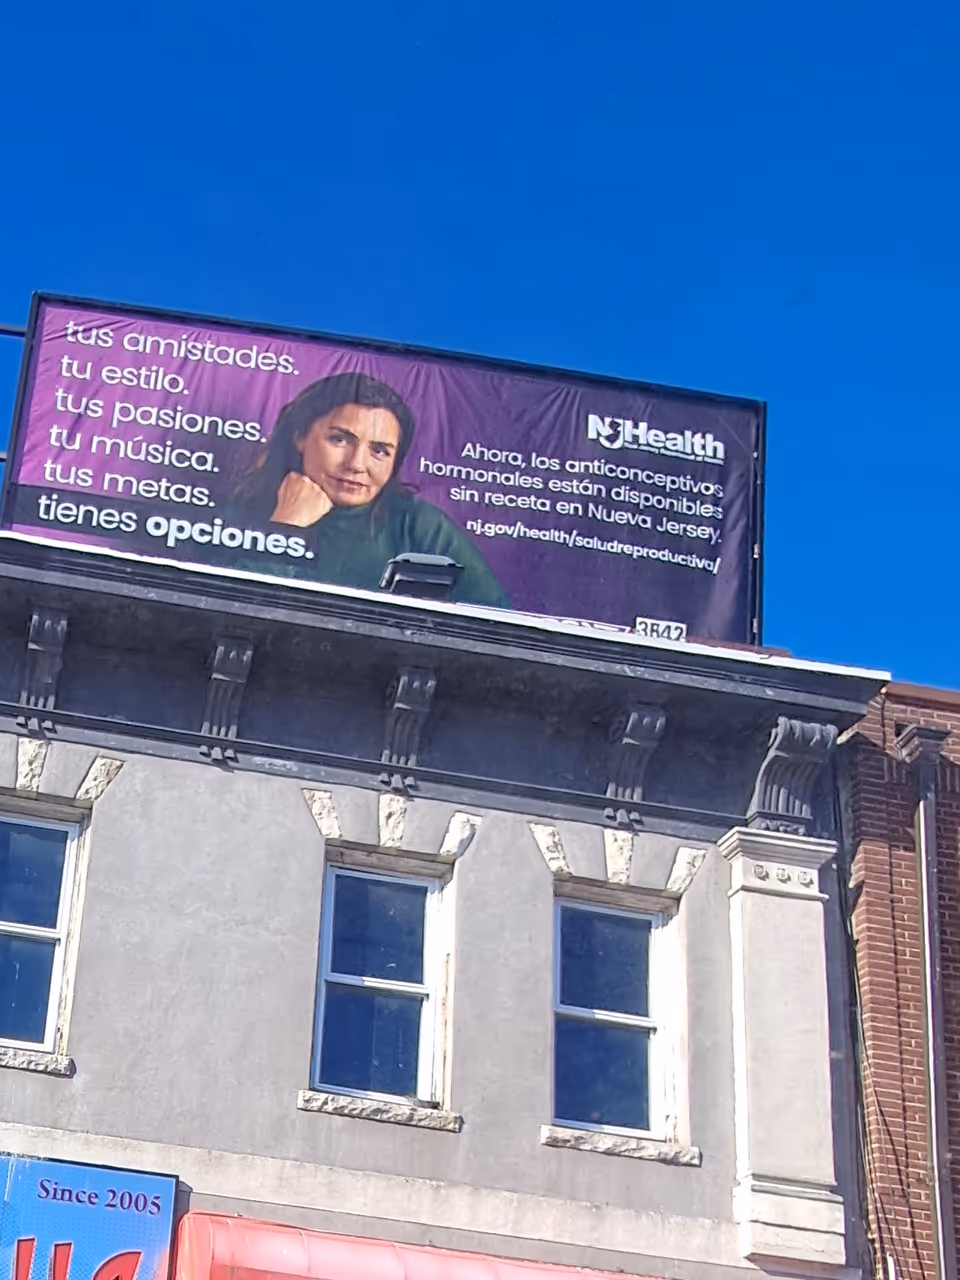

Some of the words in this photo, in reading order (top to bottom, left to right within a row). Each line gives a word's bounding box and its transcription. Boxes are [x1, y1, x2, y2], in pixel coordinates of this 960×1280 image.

[60, 354, 92, 380] tu
[101, 364, 189, 395] estilo.
[65, 321, 114, 347] tus
[123, 332, 300, 375] amistades.
[55, 386, 103, 418] tus
[112, 400, 267, 443] pasiones.
[49, 424, 81, 450] tu
[91, 435, 220, 472] música.
[461, 442, 525, 468] Ahora,
[531, 452, 560, 470] los
[565, 455, 723, 498] anticonceptivos
[44, 459, 93, 487] tus
[103, 471, 215, 507] metas.
[419, 457, 543, 490] hormonales
[548, 476, 606, 498] están
[611, 485, 723, 519] disponibles
[38, 494, 137, 532] tienes
[146, 515, 315, 559] opciones.
[450, 485, 479, 503] sin
[485, 491, 551, 512] receta
[556, 500, 583, 516] en
[588, 503, 651, 529] Nueva
[656, 517, 723, 545] Jersey.
[466, 519, 721, 574] nj.gov/health/saludreproductiva/
[37, 1179, 99, 1206] Since
[104, 1189, 161, 1215] 2005
